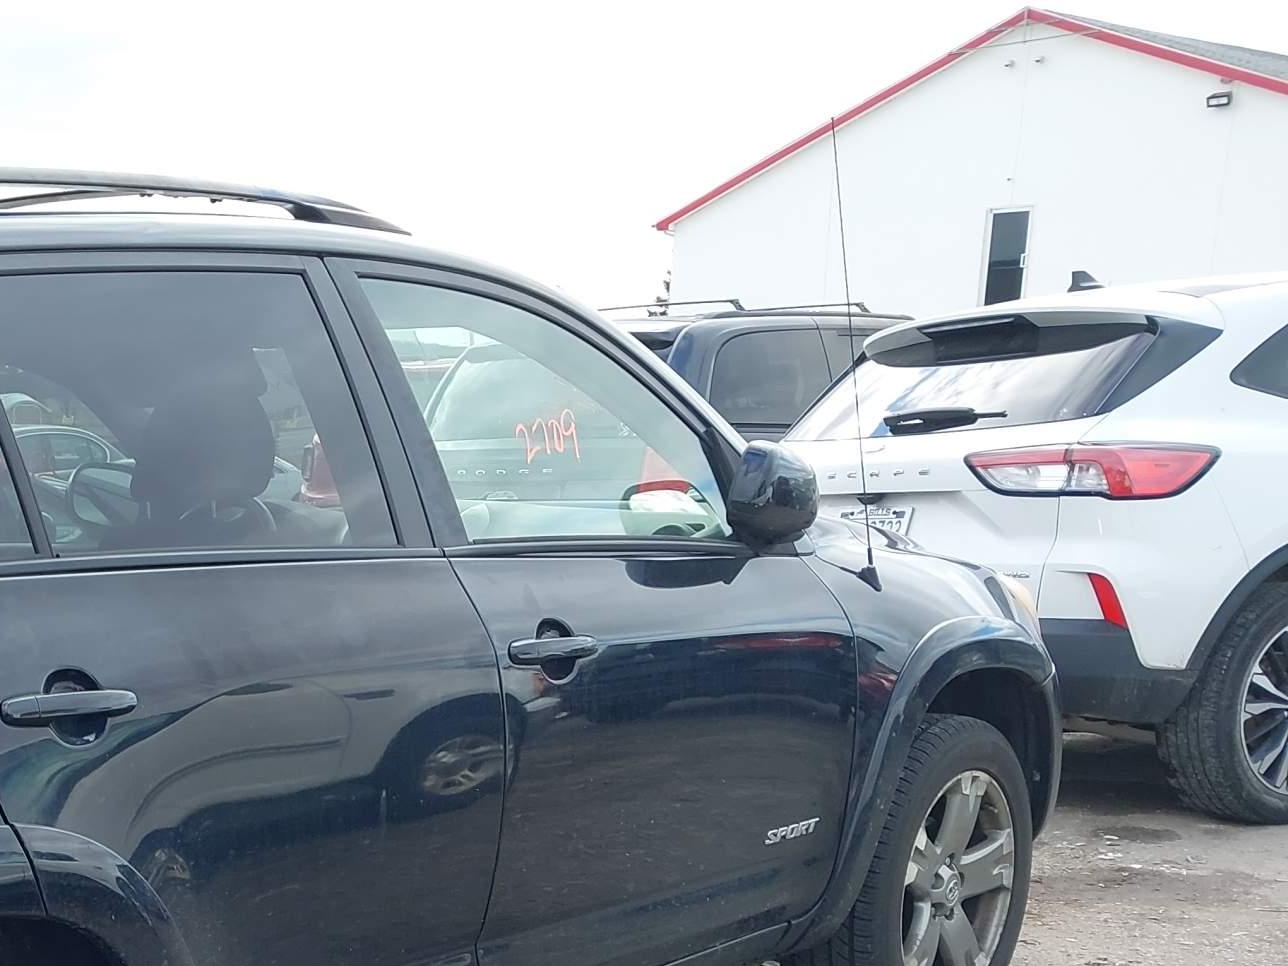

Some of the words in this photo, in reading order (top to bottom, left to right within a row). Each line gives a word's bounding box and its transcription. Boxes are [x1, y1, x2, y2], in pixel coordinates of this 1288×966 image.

[515, 408, 581, 464] 2709
[827, 468, 931, 480] SCAPE
[764, 817, 820, 845] SPORT
